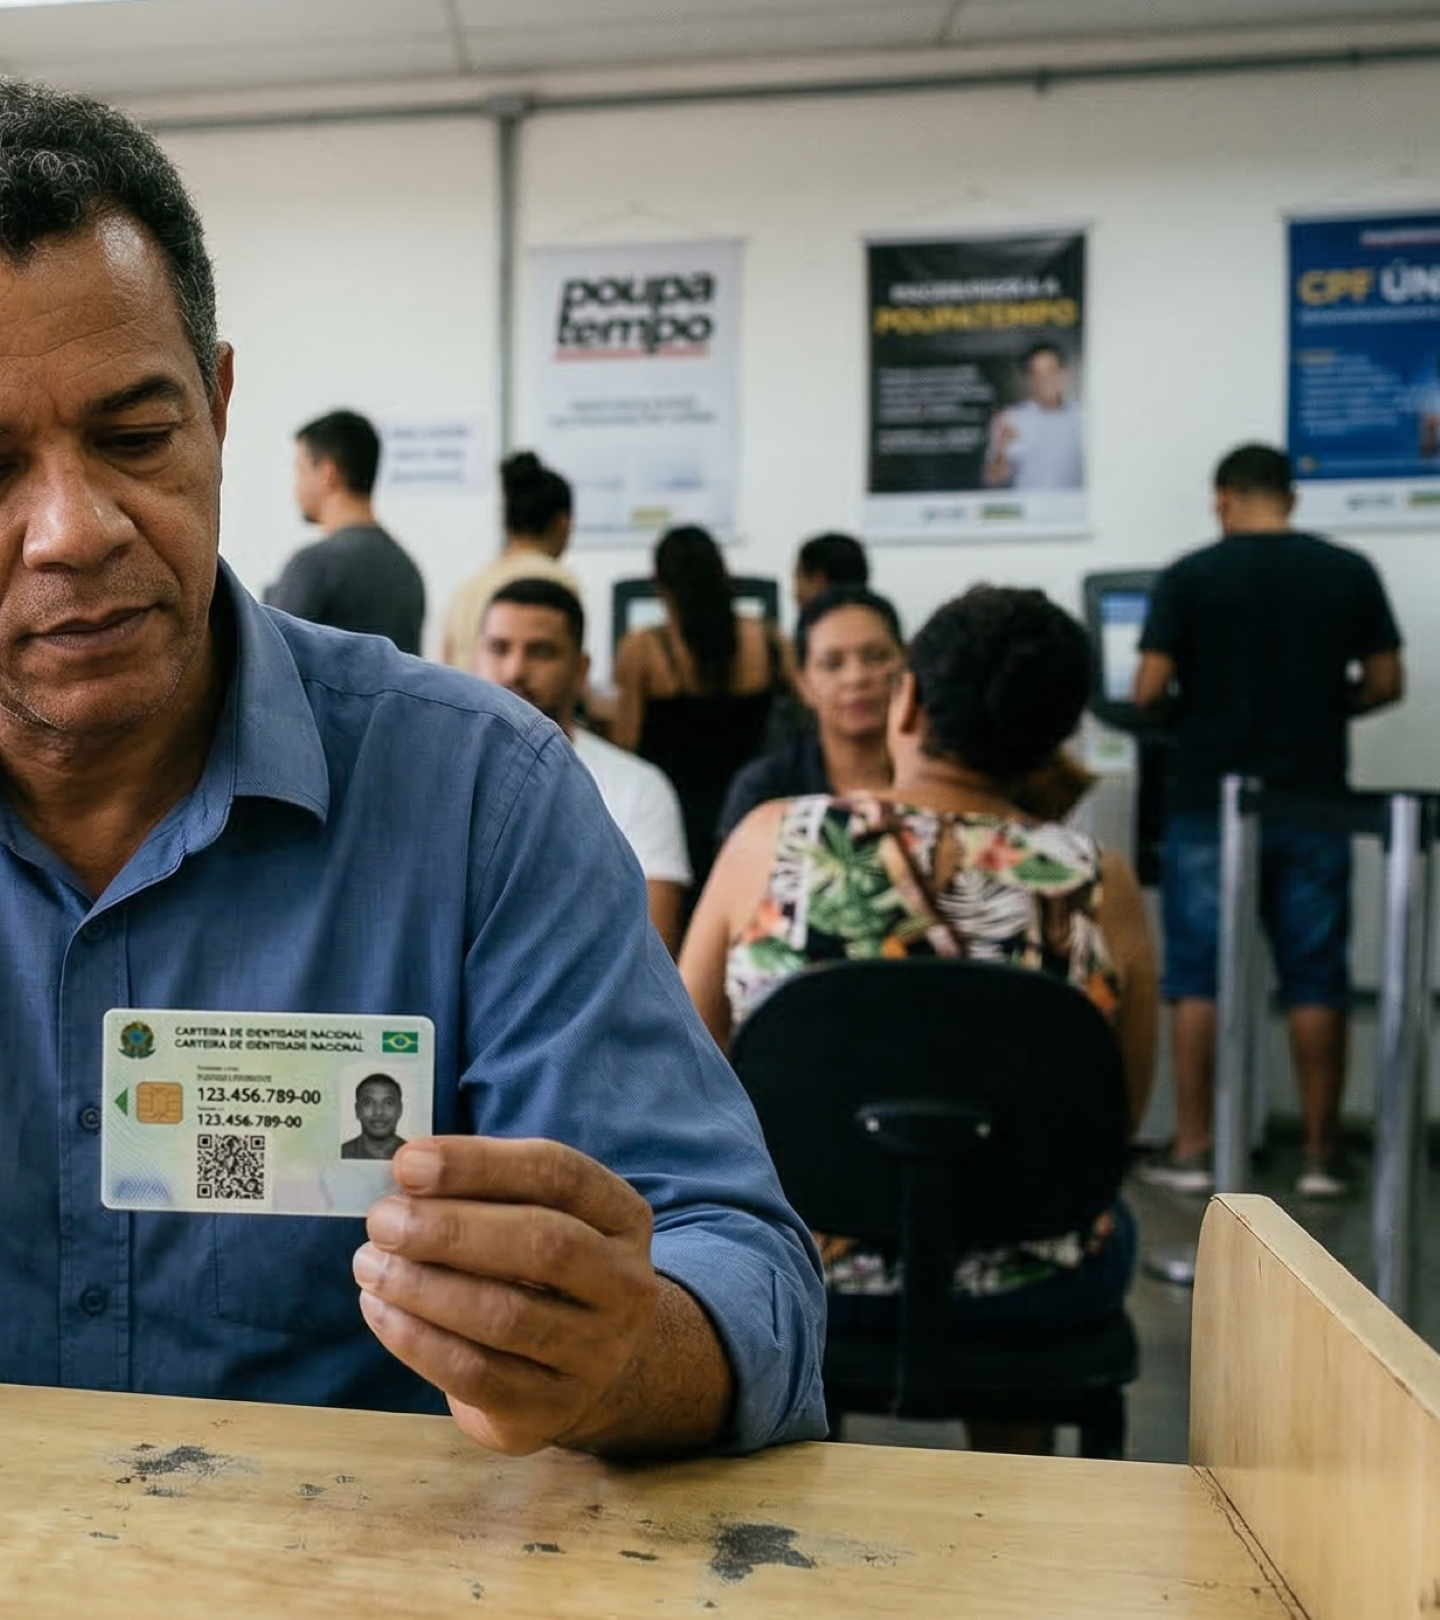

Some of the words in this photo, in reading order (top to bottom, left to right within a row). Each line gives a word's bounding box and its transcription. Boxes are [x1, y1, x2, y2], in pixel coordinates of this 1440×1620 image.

[562, 272, 715, 318] poupa
[1299, 267, 1375, 306] CPF
[559, 312, 714, 355] tempo
[175, 1026, 227, 1037] CARTEIRA
[230, 1028, 243, 1038] DE
[311, 1030, 364, 1040] NACIONAL
[175, 1039, 227, 1049] CARTEIRA
[198, 1087, 321, 1105] 123.456.789-00
[198, 1113, 302, 1129] 123.456.789-00
